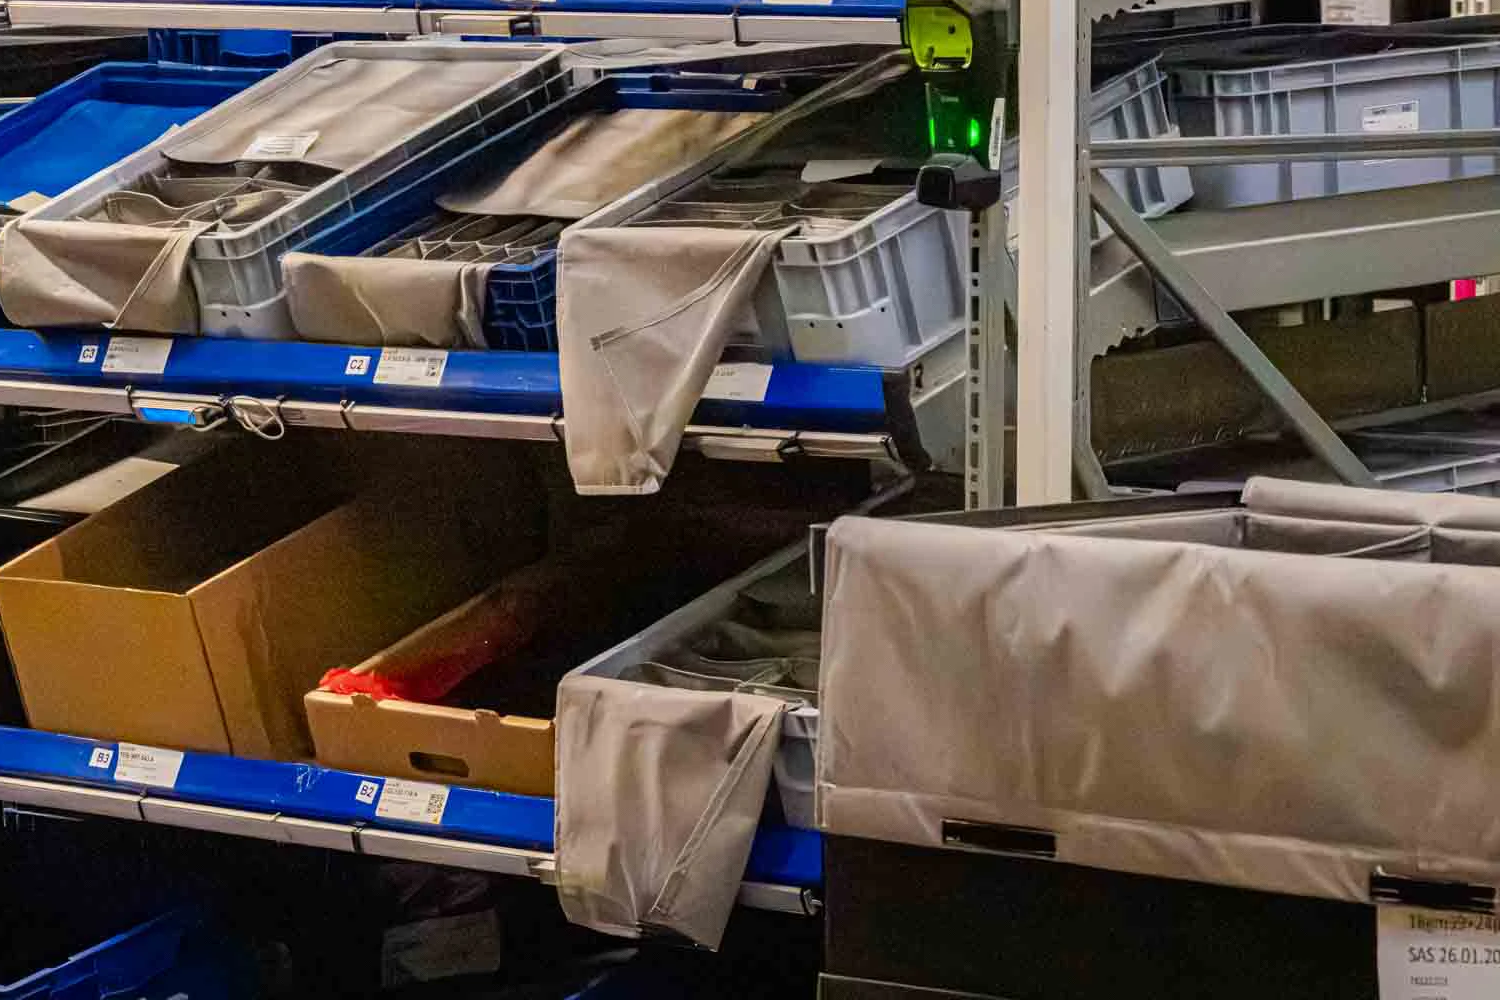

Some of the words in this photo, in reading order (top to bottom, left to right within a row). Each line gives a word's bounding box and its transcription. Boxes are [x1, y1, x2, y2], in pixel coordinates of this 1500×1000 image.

[349, 359, 364, 370] C2
[360, 784, 374, 798] B2
[1408, 946, 1435, 963] SAS
